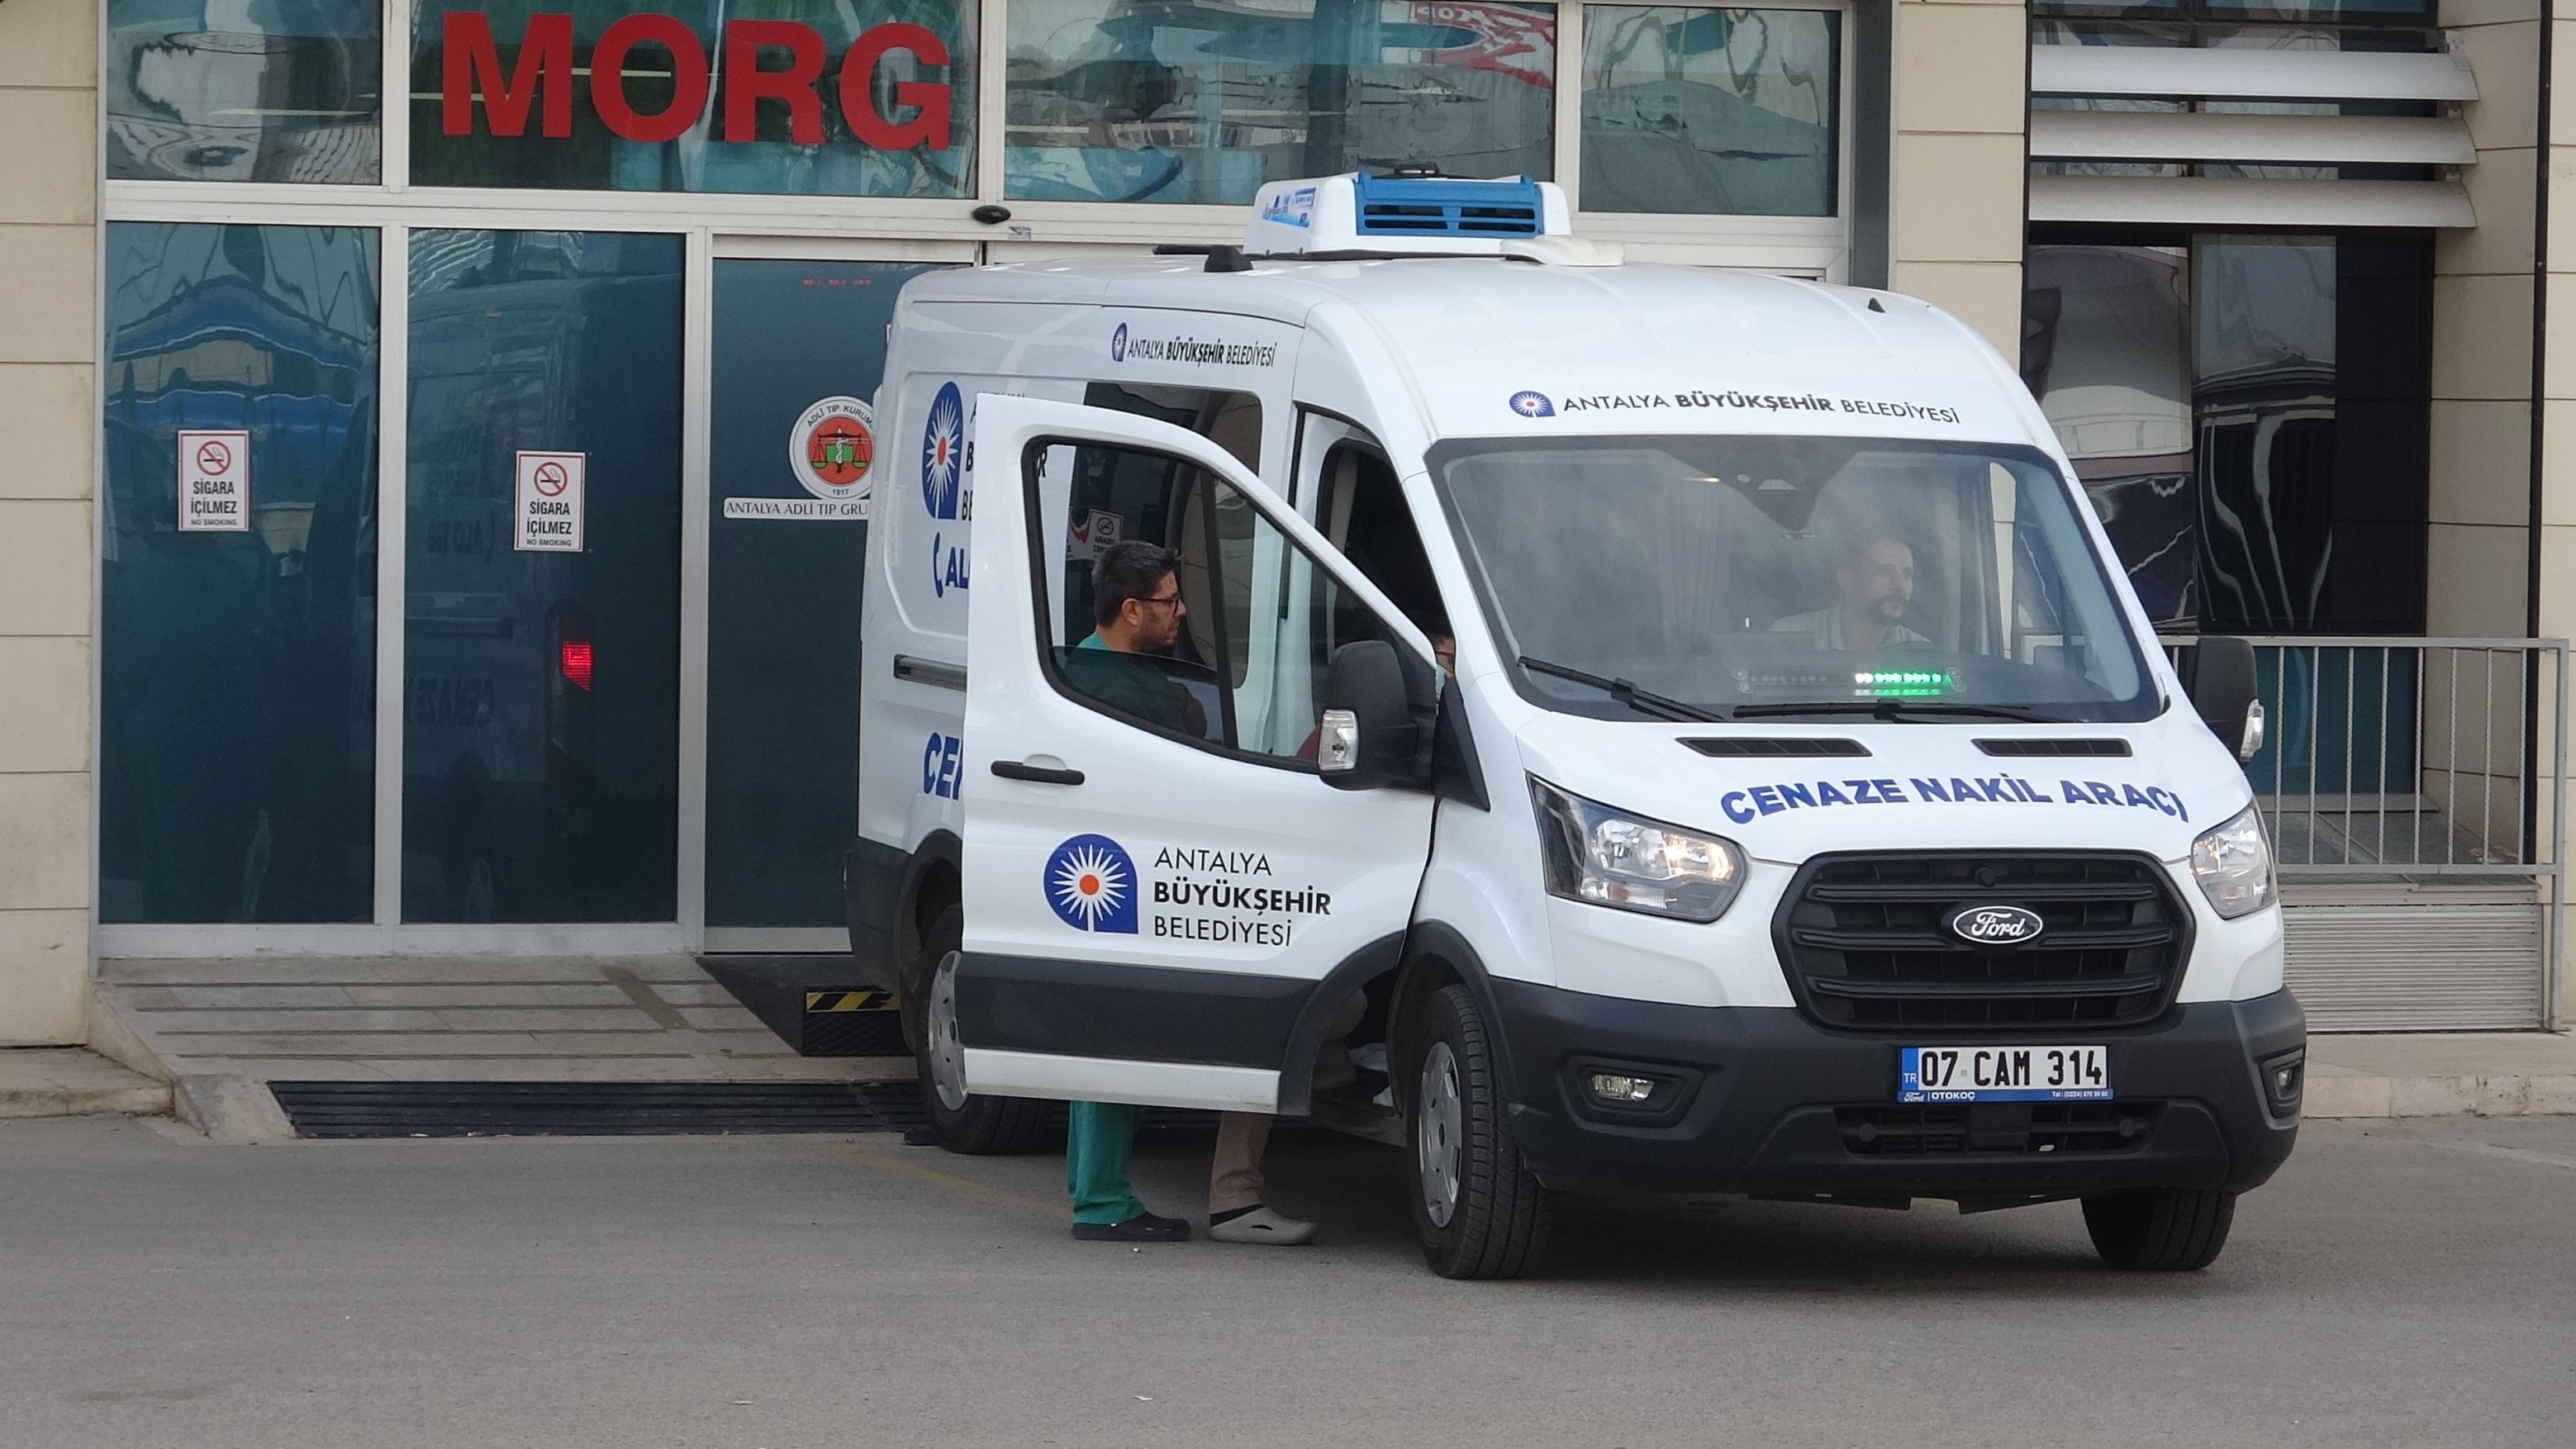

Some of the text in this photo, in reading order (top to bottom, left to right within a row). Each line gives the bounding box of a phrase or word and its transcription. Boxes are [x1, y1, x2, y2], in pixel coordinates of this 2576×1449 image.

[442, 12, 951, 150] MORG
[1127, 336, 1277, 368] ANTALYA BÜYÜKŞEHİR BELEDİYESİ
[807, 405, 872, 428] ADLİ TIP KURUM
[1564, 391, 1961, 424] ANTALYA BÜYÜKŞEHİR BELEDİYESİ
[192, 478, 235, 494] SİGARA
[191, 497, 237, 517] İÇİLMEZ
[530, 498, 570, 515] SİGARA
[725, 502, 780, 515] ANTALYA
[785, 501, 813, 515] ADLİ
[817, 503, 836, 515] TIP
[526, 517, 572, 537] İÇİLMEZ
[1721, 772, 2189, 824] CENAZE NAKİL ARACI
[1154, 847, 1272, 876] ANTALYA
[1154, 876, 1331, 916] BÜYÜKŞEHİR
[1154, 915, 1291, 947] BELEDİYESİ
[1971, 912, 2026, 936] Ford
[1903, 1050, 2102, 1086] TR 07 CAM 314
[1903, 1091, 1975, 1102] Ford OTOKOÇ
